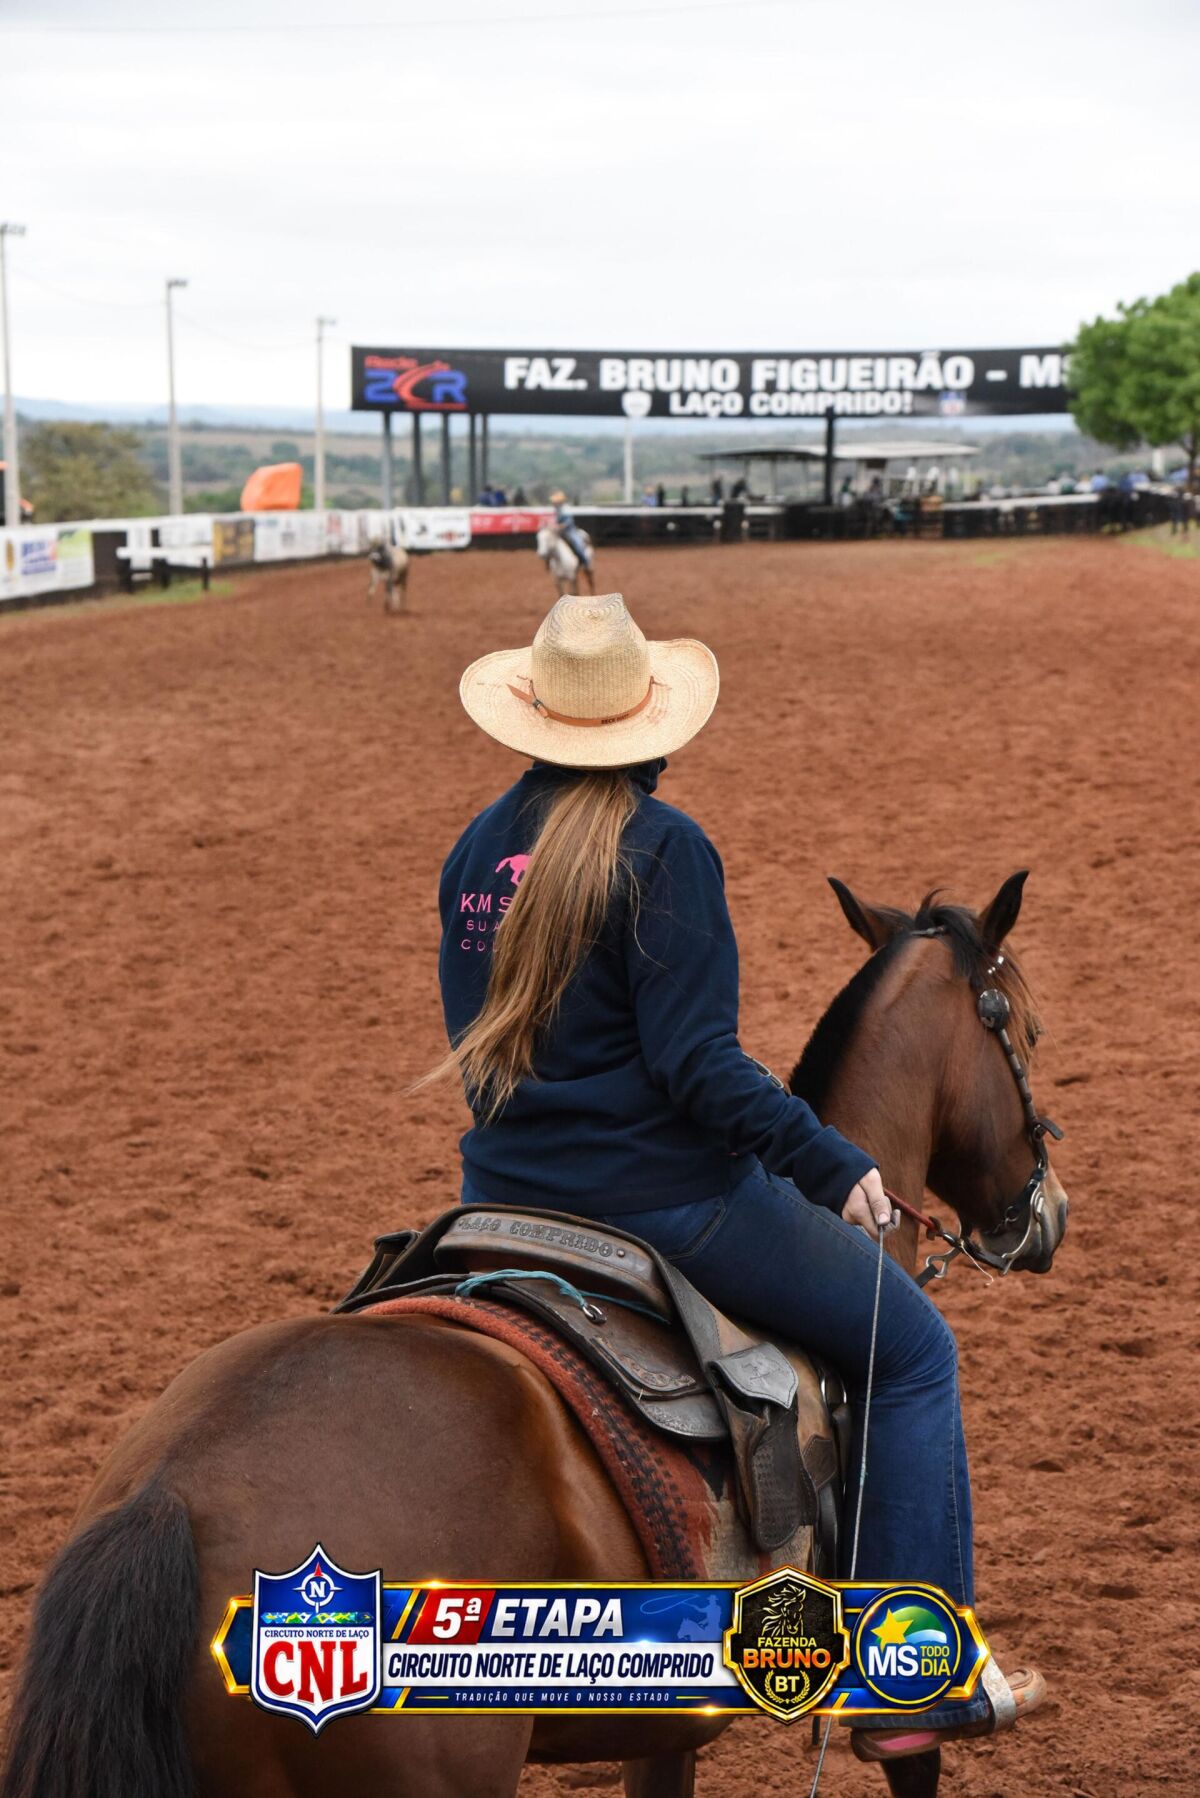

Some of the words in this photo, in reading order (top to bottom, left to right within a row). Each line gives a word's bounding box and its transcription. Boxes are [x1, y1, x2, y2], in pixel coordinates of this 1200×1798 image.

[504, 357, 588, 390] FAZ.
[599, 358, 740, 392] BRUNO
[751, 350, 975, 391] FIGUEIRÃO
[669, 391, 744, 417] LAÇO
[749, 390, 914, 416] COMPRIDO!
[459, 893, 492, 913] KM
[498, 896, 513, 913] S
[460, 939, 496, 951] CO
[509, 1220, 614, 1258] COMPRIDO
